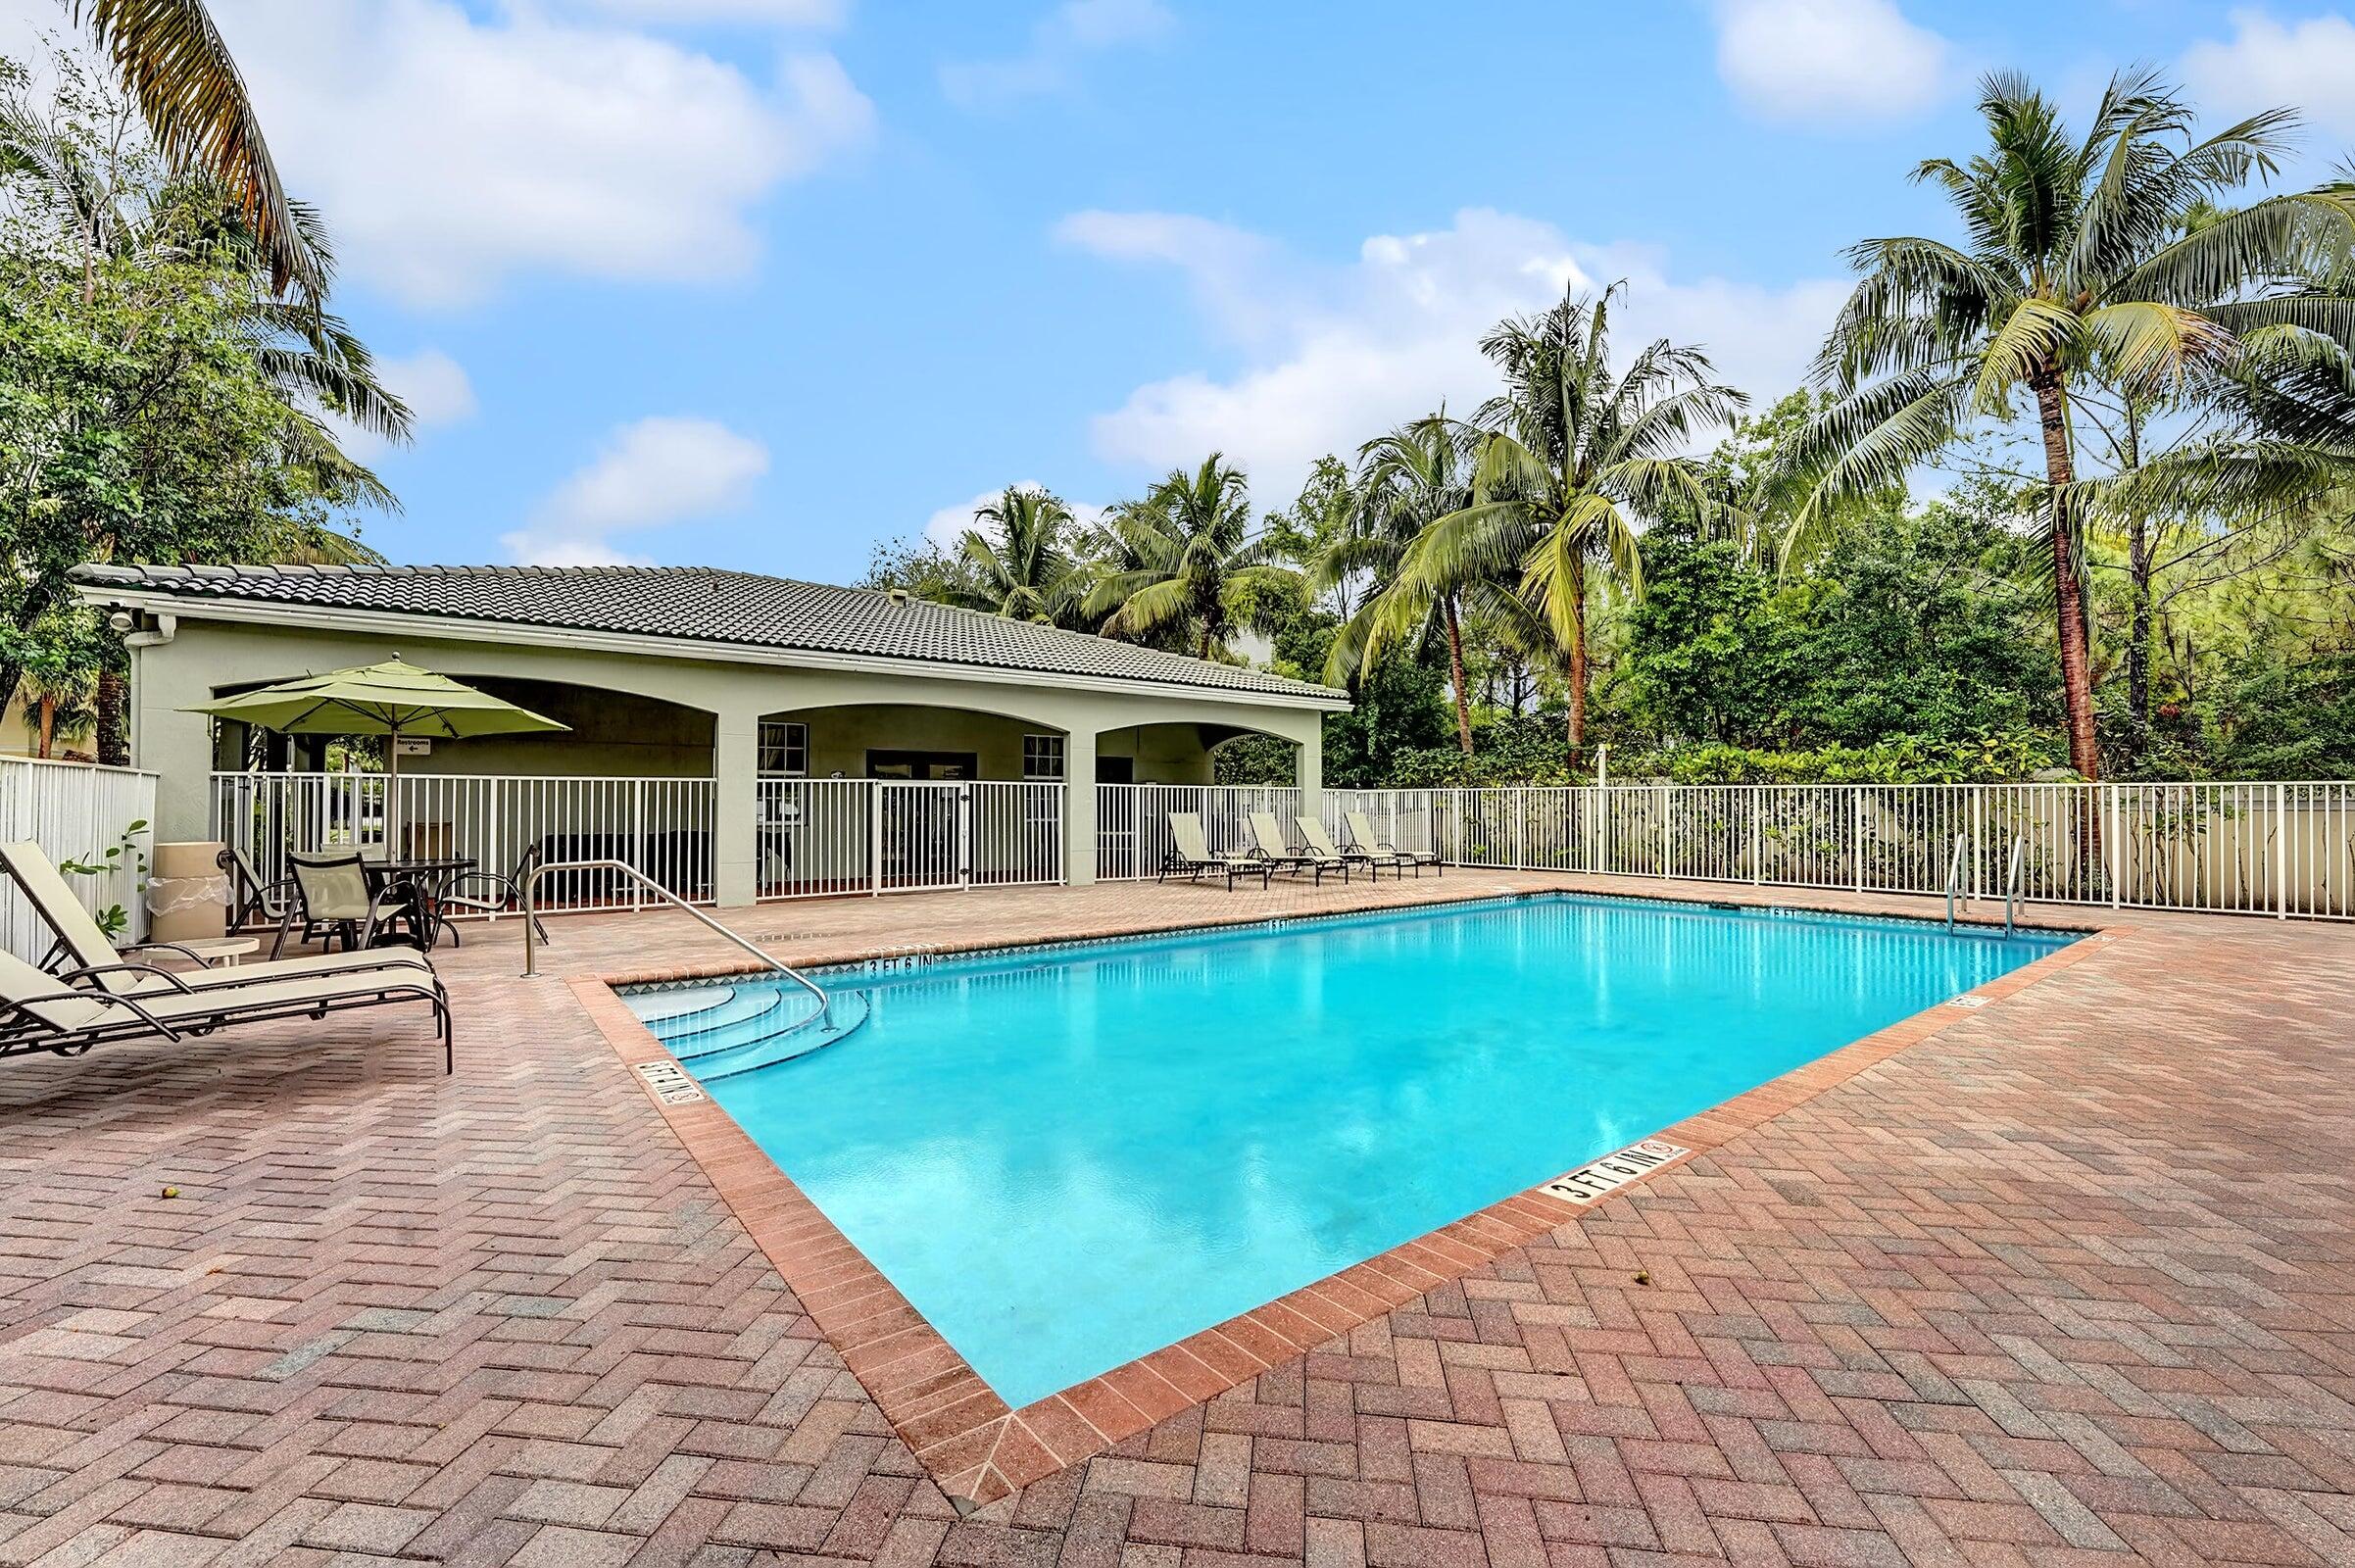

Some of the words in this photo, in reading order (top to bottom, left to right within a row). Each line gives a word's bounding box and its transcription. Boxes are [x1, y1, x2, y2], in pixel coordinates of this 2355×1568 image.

[883, 957, 900, 971] FT
[1614, 1150, 1666, 1168] IN
[1599, 1162, 1638, 1175] 6
[1568, 1169, 1620, 1191] FT
[1550, 1184, 1592, 1199] 3
